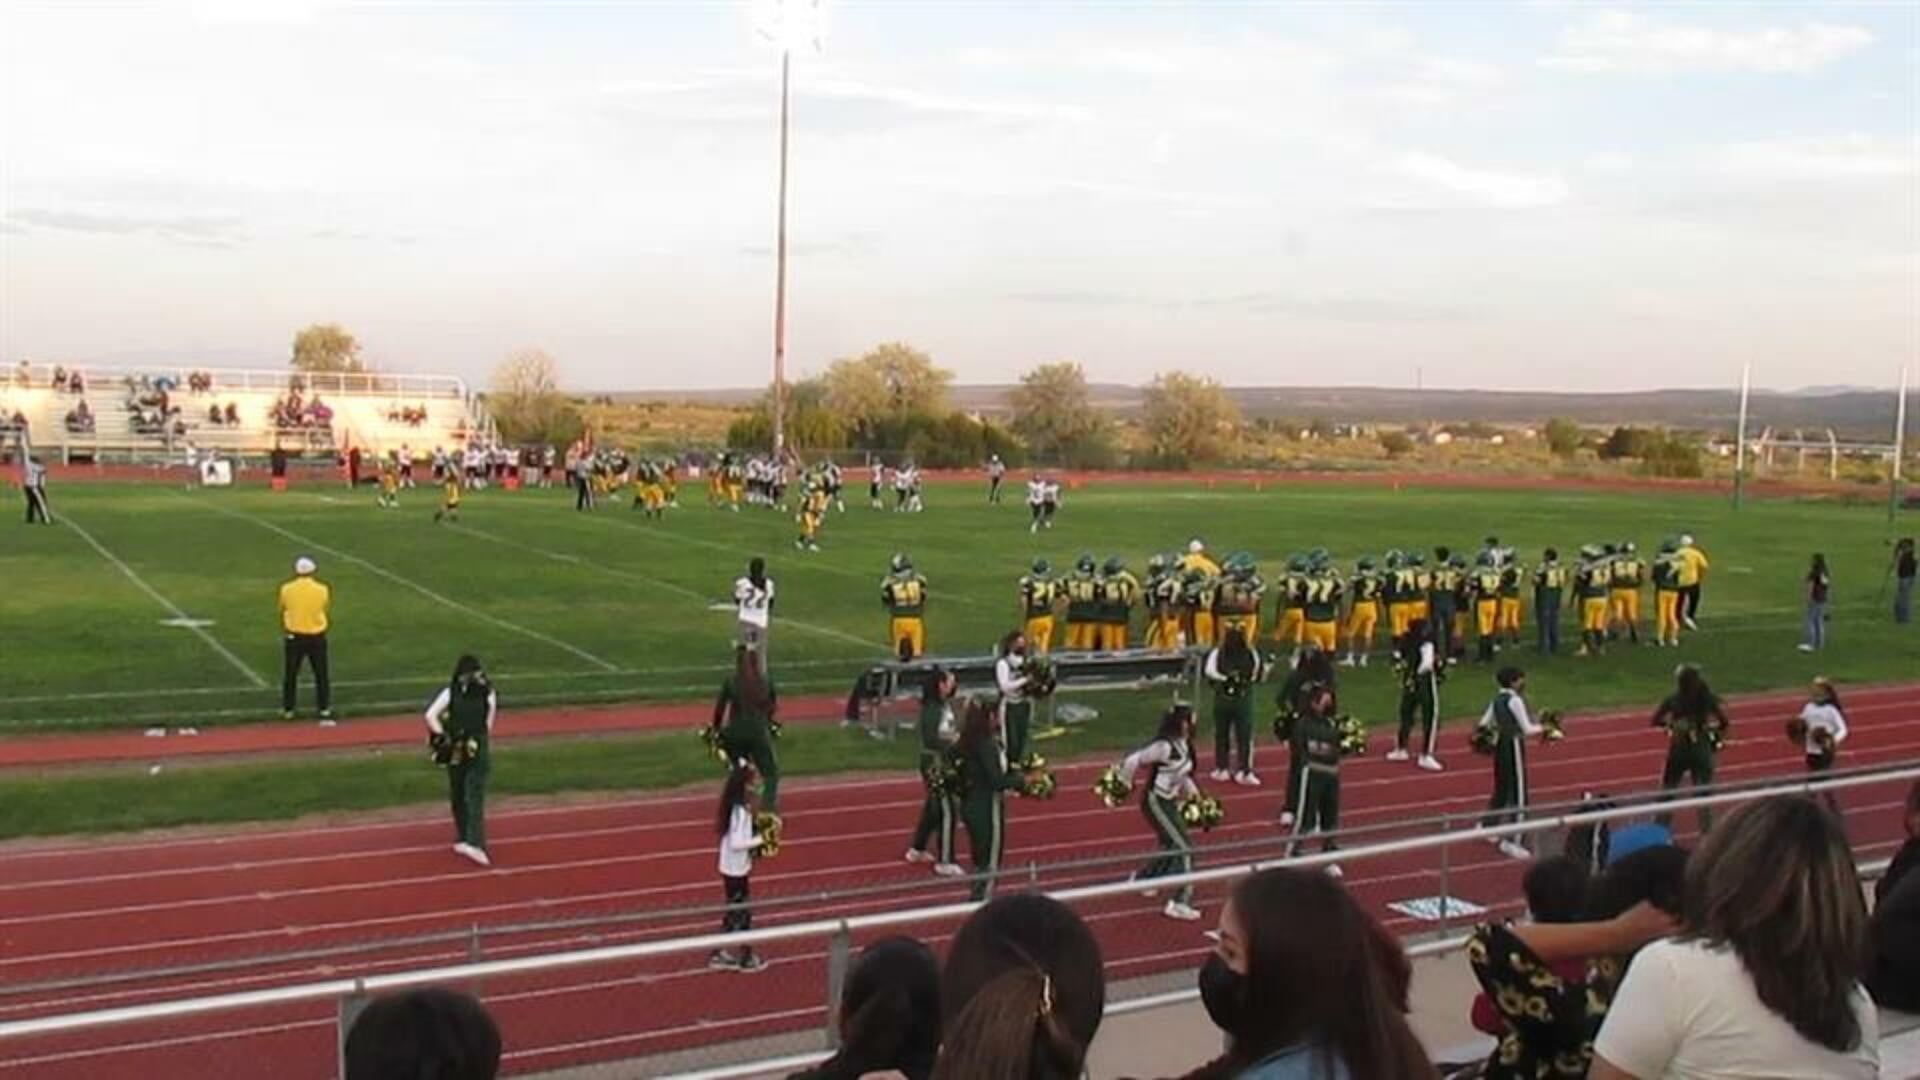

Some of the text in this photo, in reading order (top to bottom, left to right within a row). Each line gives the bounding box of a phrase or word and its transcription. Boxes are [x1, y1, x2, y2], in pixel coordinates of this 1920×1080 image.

[744, 588, 767, 609] 22
[1033, 581, 1056, 604] 21
[1306, 579, 1334, 604] 77
